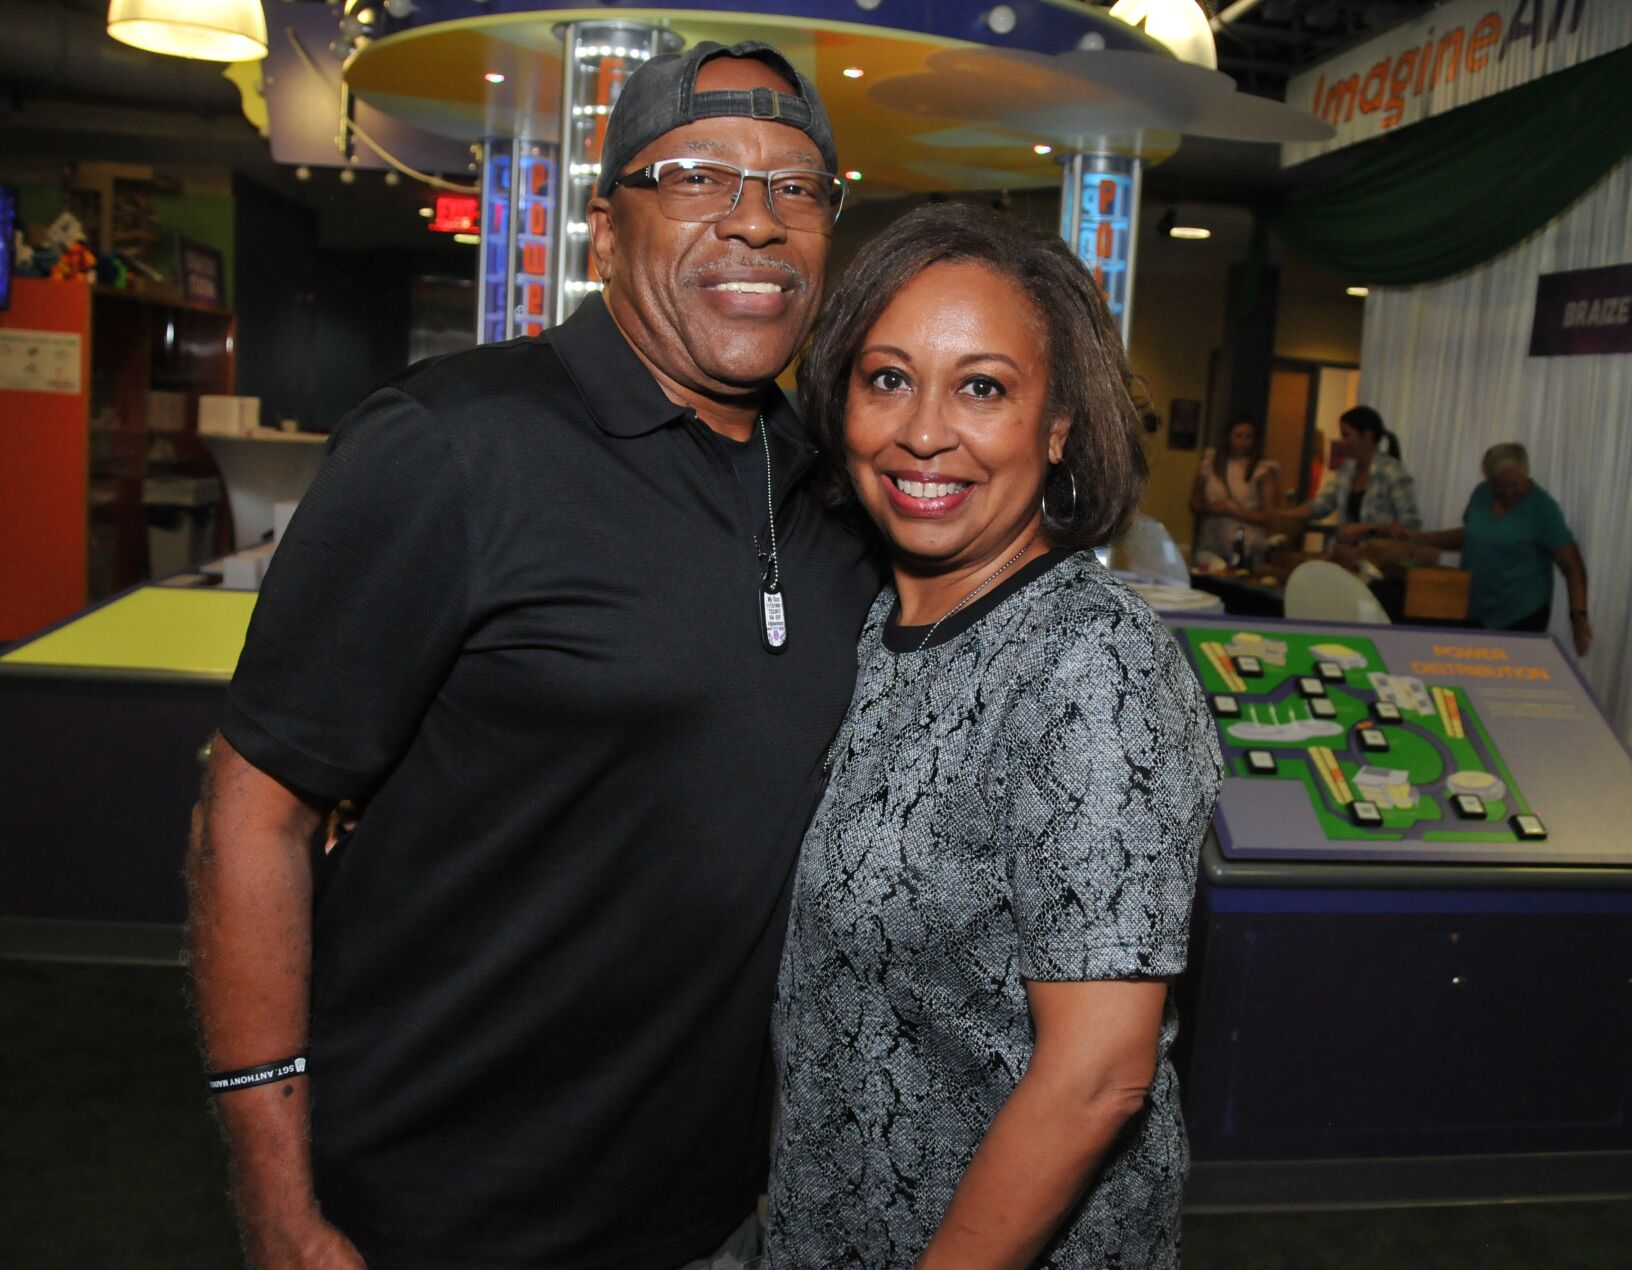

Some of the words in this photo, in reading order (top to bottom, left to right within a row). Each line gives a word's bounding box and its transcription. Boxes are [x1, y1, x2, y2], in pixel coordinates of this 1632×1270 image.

[1562, 295, 1632, 329] BRAIZE
[1432, 644, 1510, 661] POWER
[1411, 660, 1551, 682] DISTRIBUTION
[230, 1070, 274, 1086] ANTHONY
[275, 1065, 295, 1076] SGT.
